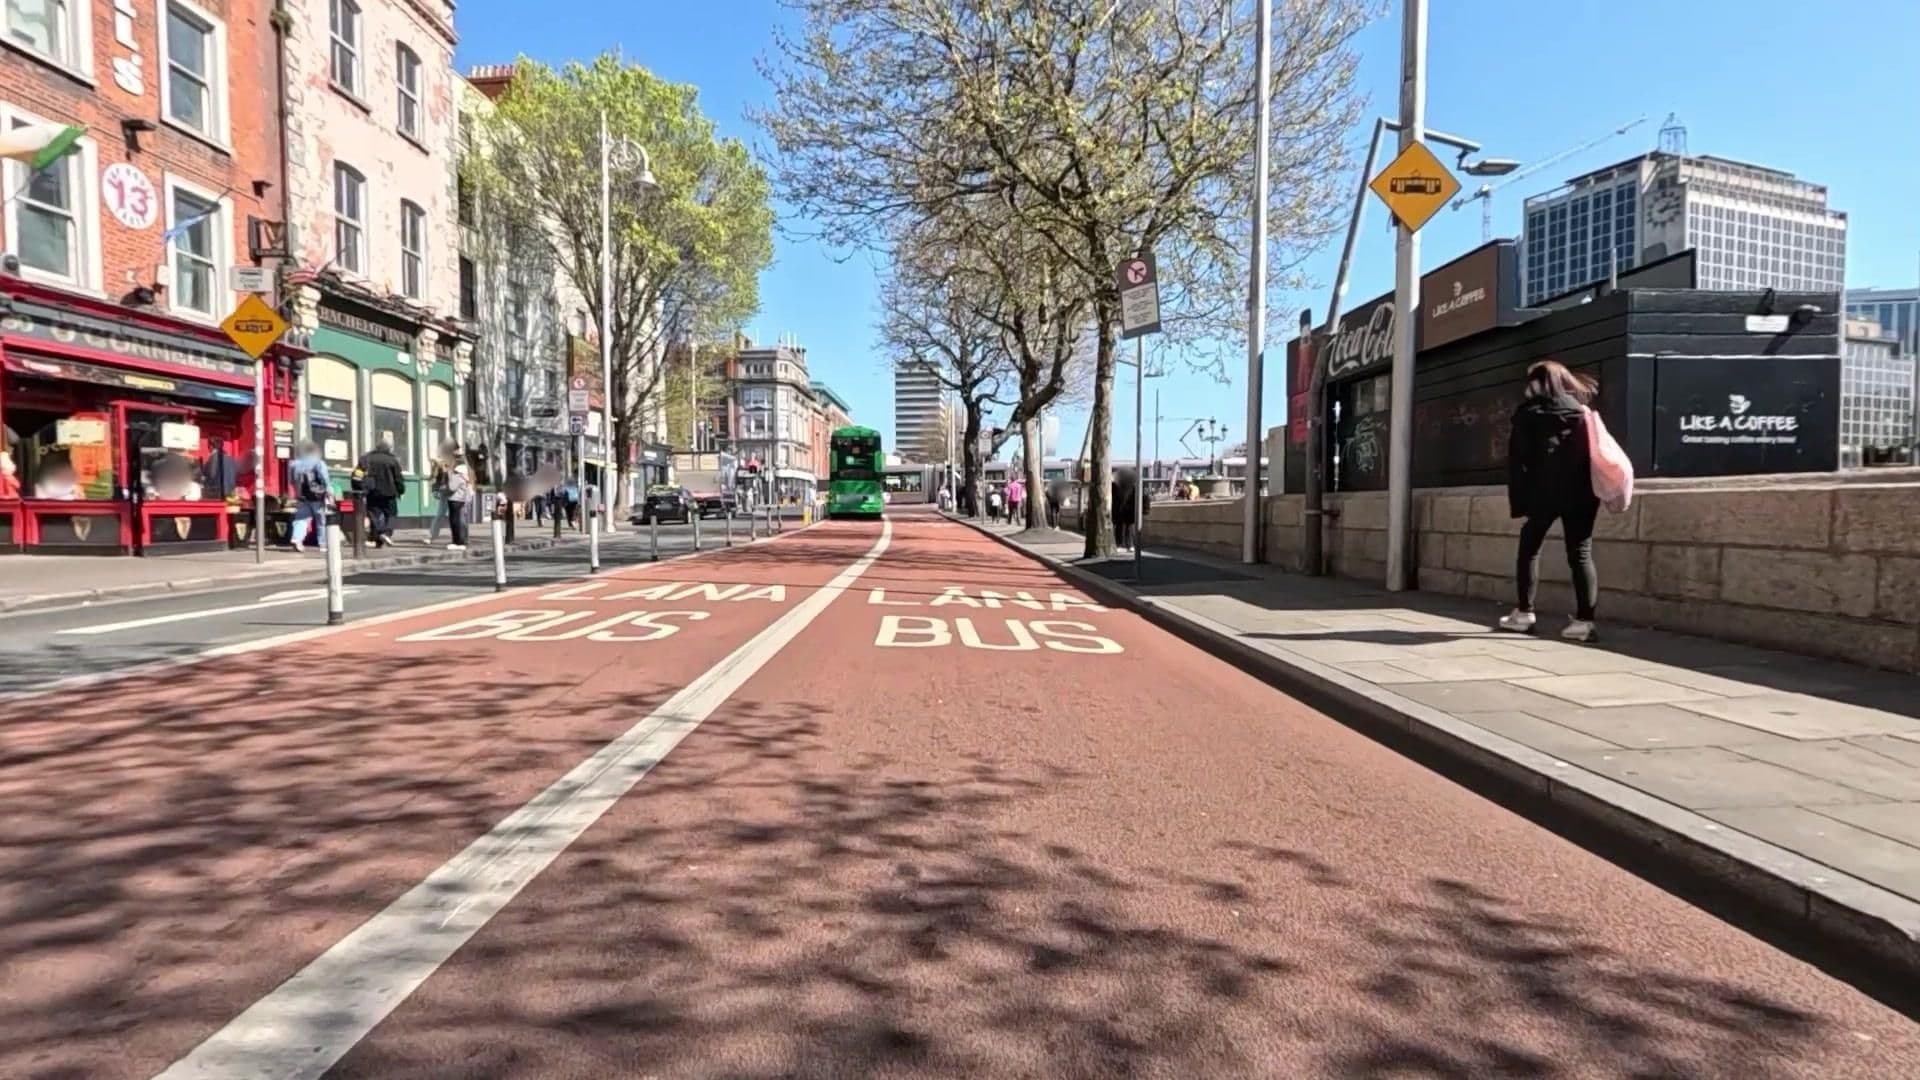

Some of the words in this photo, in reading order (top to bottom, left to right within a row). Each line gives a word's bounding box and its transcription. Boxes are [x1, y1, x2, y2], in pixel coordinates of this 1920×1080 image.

[107, 178, 149, 218] 13
[1680, 415, 1717, 430] LIKE
[1719, 415, 1733, 431] A
[1734, 415, 1799, 431] COFFEE
[394, 610, 711, 642] BUS
[874, 615, 1125, 654] BUS
